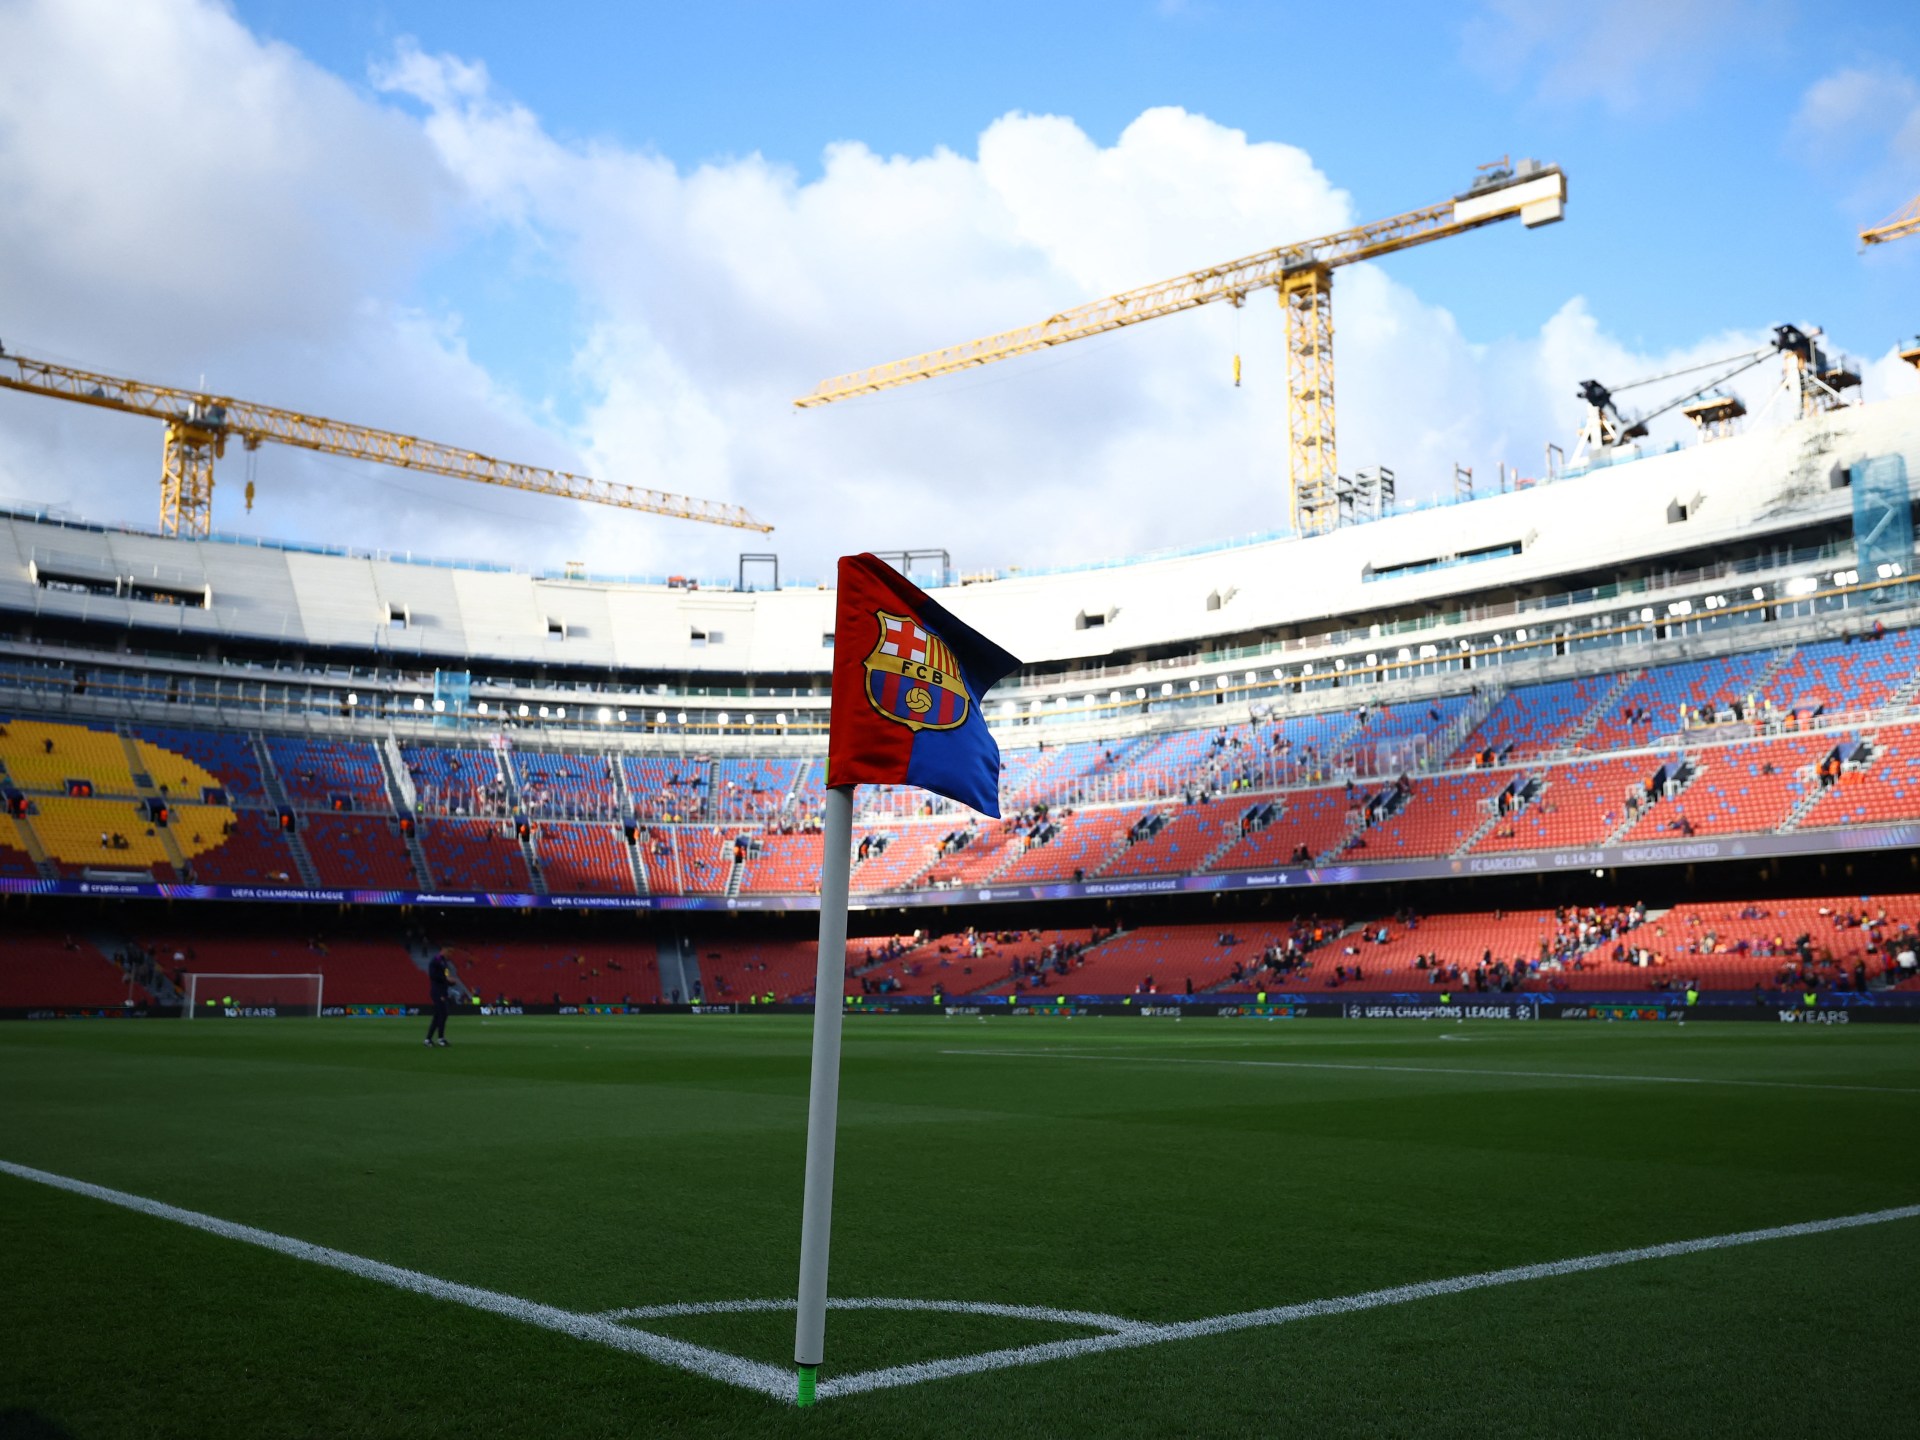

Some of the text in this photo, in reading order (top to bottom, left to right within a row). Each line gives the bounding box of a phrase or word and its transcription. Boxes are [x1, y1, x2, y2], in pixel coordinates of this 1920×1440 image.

[901, 660, 944, 685] FCB
[1622, 843, 1719, 861] NEWCASTLE UNITED
[1471, 856, 1537, 872] FC BARCELONA
[91, 884, 139, 894] crypto.com
[1104, 883, 1147, 892] CHAMPIONS
[1148, 880, 1176, 890] LEAGUE
[231, 889, 344, 899] UEFA CHAMPIONS LEAGUE
[551, 897, 651, 907] UEFA CHAMPIONS LEAGUE
[238, 1007, 276, 1017] YEARS
[492, 1006, 523, 1015] YEARS
[1151, 1007, 1181, 1016] YEARS
[1366, 1006, 1510, 1018] UEFA CHAMPIONS LEAGUE
[1561, 1007, 1587, 1018] UEFA
[1796, 1010, 1849, 1023] YEARS
